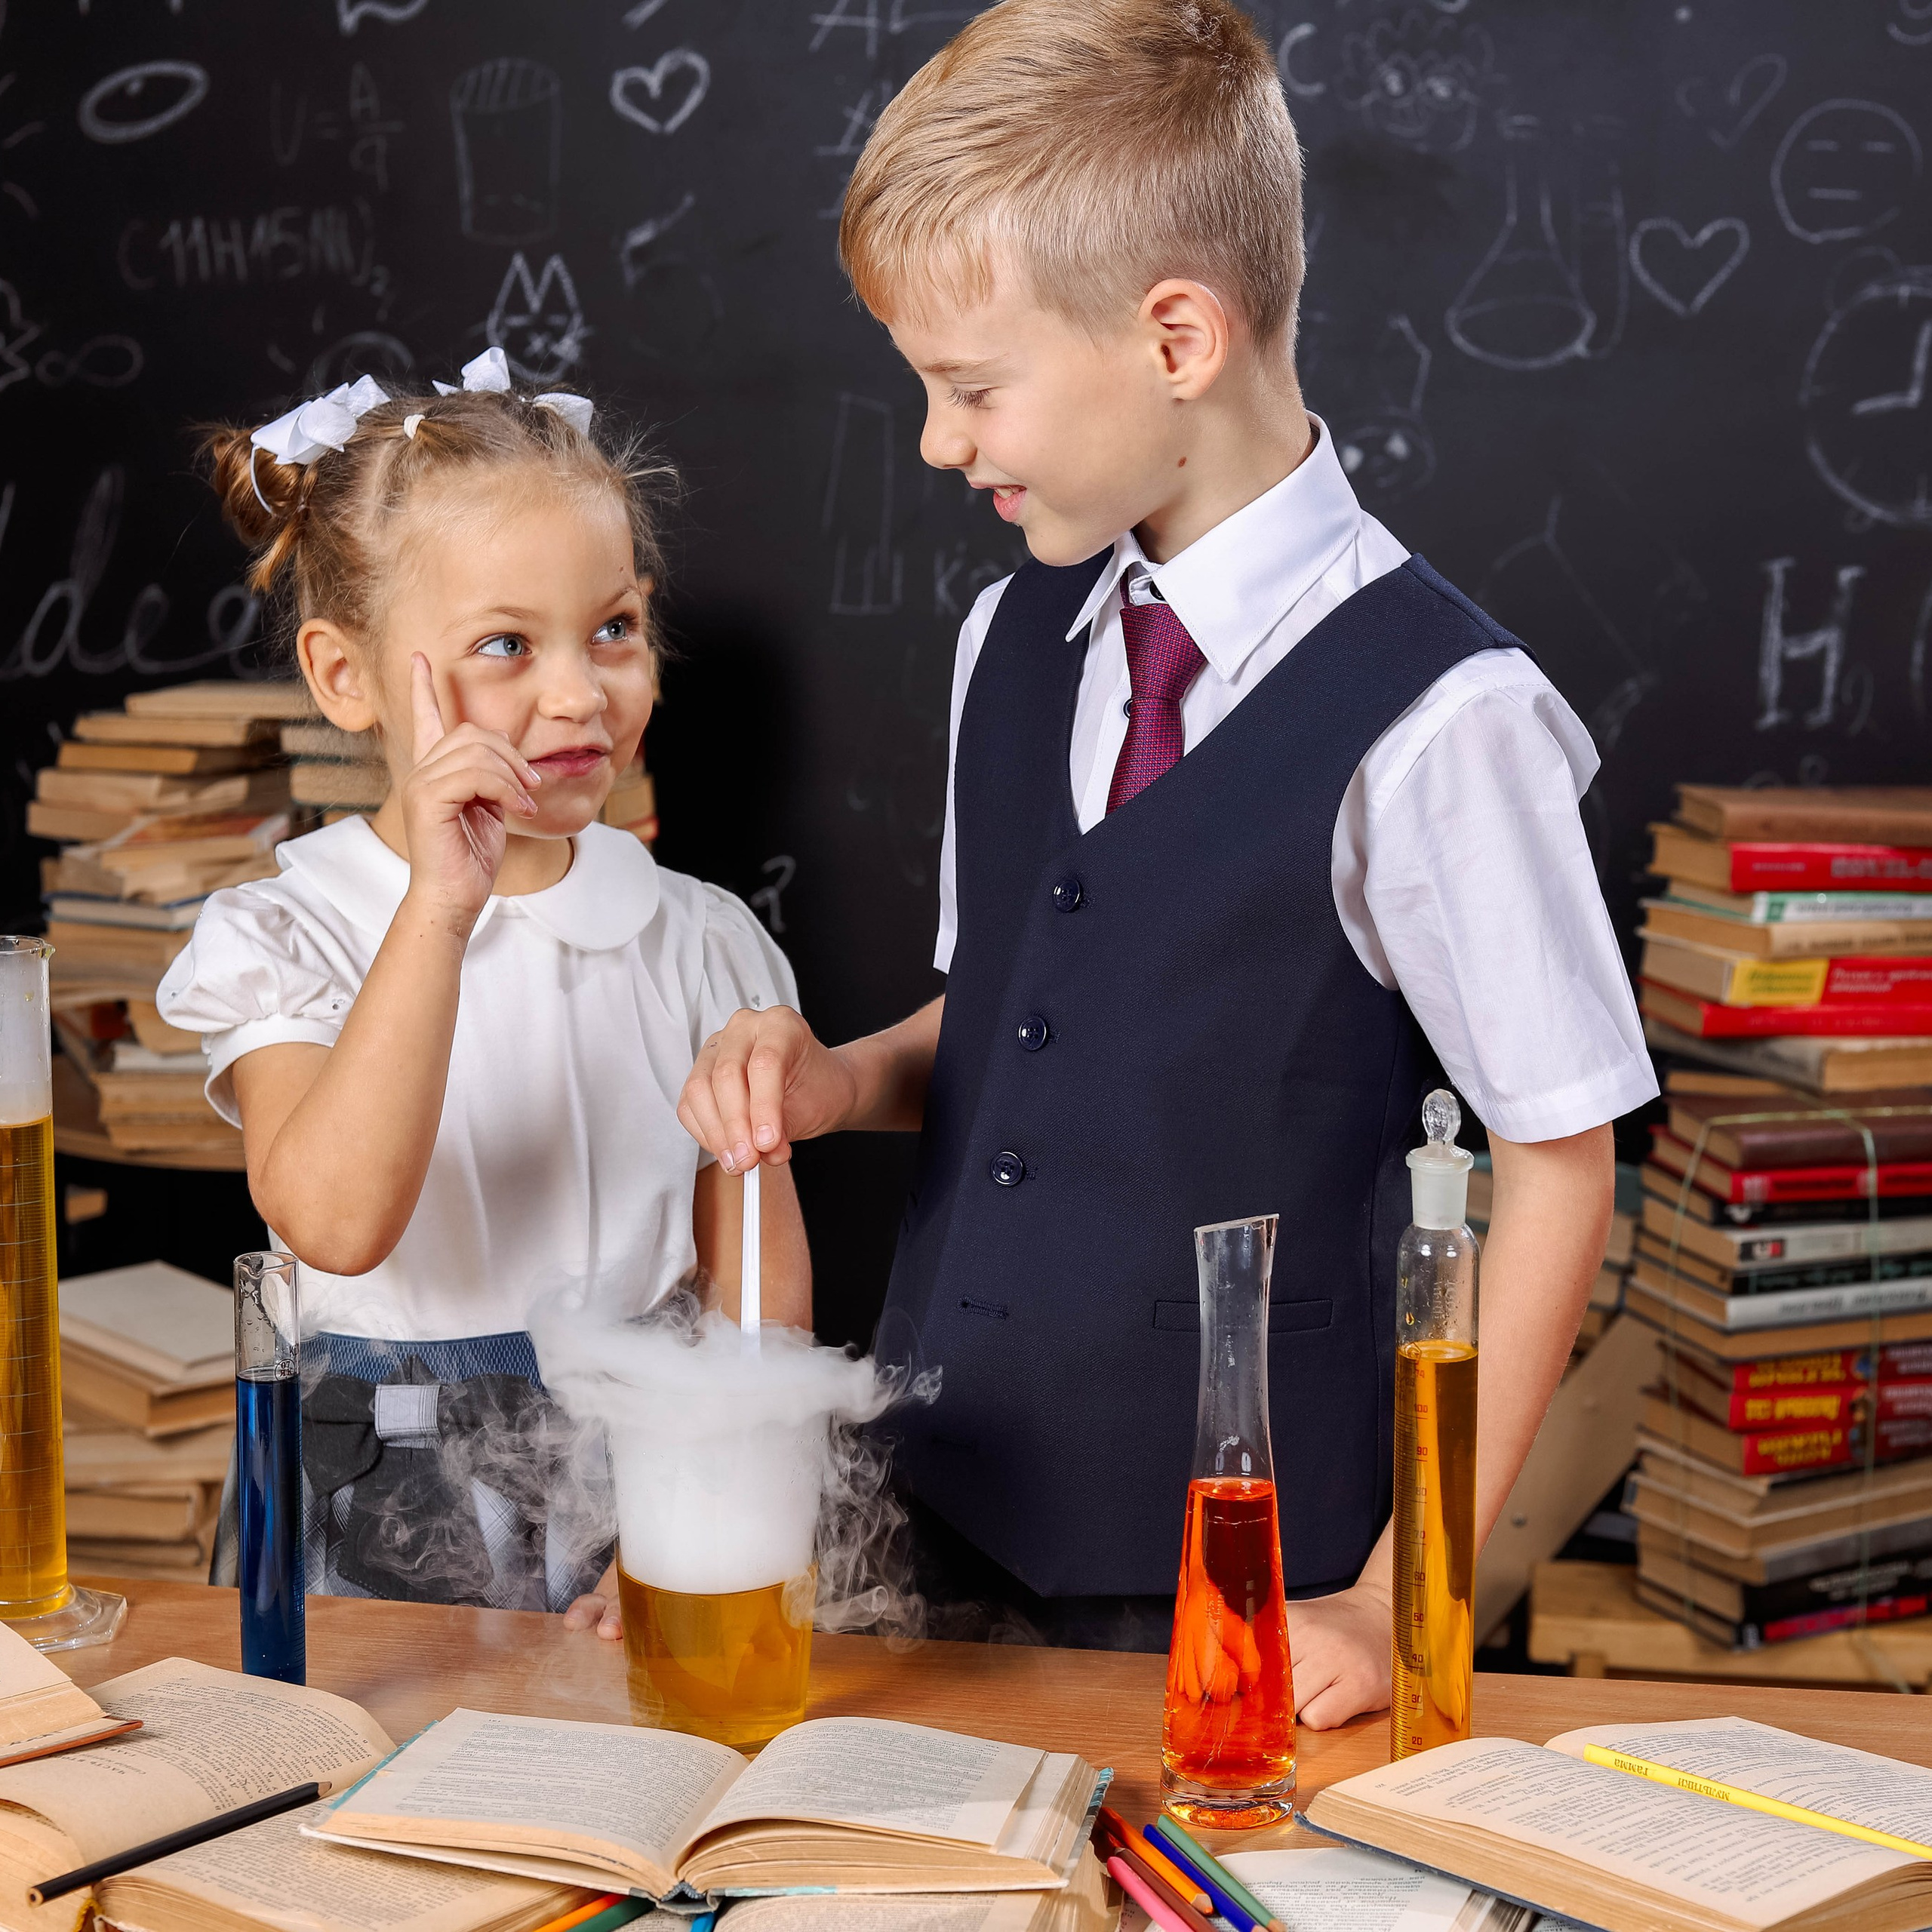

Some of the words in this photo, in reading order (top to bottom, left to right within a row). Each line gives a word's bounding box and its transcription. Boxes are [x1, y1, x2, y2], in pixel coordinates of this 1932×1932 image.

[1416, 1446, 1428, 1457] 90
[1414, 1530, 1426, 1540] 70
[1413, 1612, 1425, 1623] 50
[1411, 1654, 1424, 1663] 40
[1411, 1694, 1423, 1704] 30
[1411, 1736, 1423, 1746] 20
[1613, 1758, 1649, 1777] гамма
[1677, 1777, 1730, 1802] МУЛЬТИКИ
